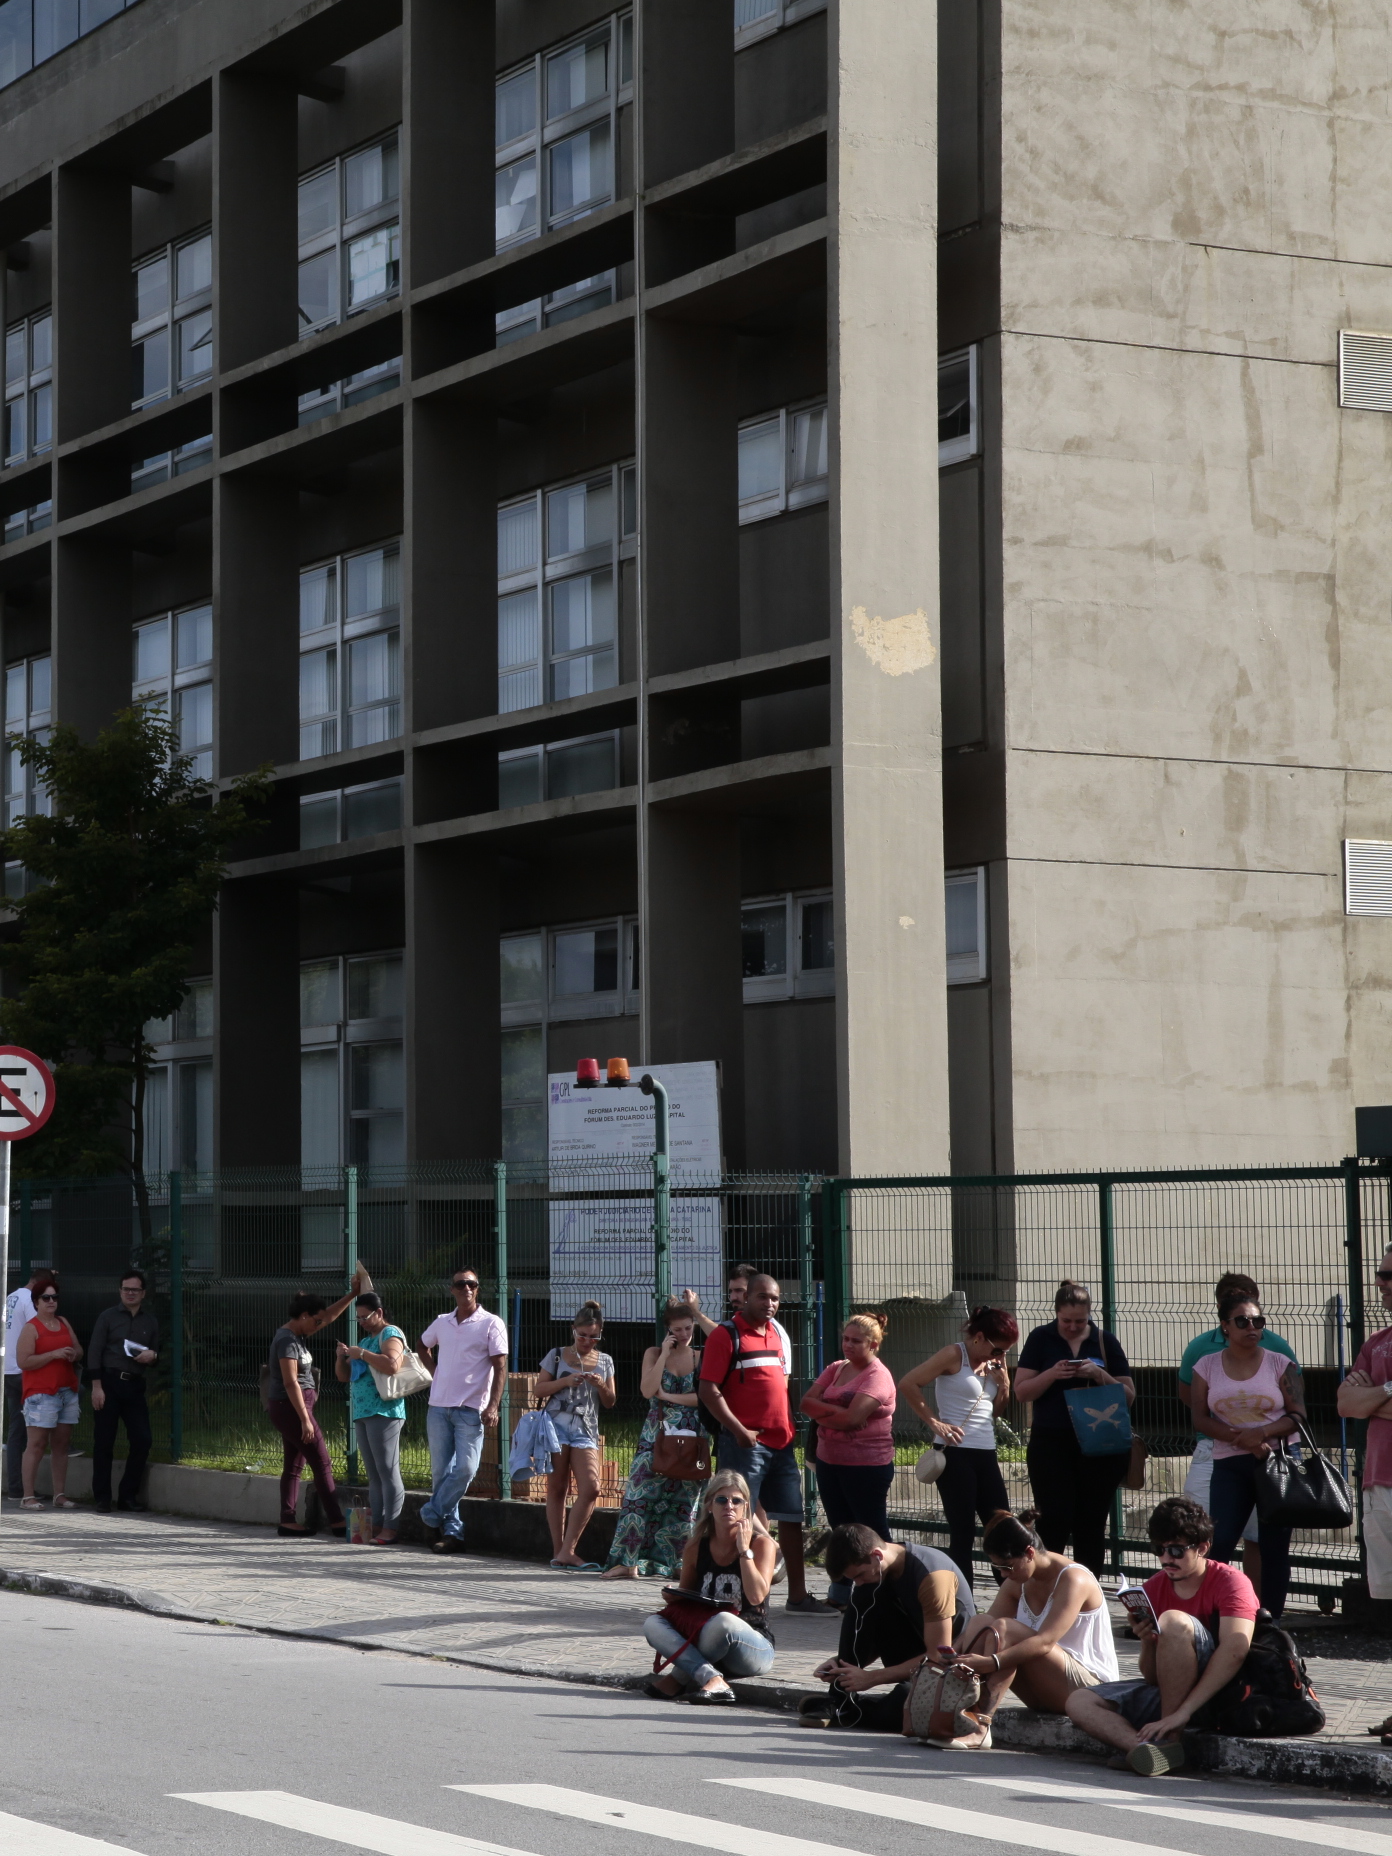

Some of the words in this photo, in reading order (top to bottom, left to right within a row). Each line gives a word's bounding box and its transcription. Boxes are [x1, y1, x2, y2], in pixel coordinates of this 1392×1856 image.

[587, 1107, 613, 1115] REFORMA
[613, 1105, 638, 1113] PARCIAL
[616, 1113, 645, 1121] EDUARDO
[677, 1205, 712, 1213] CATARINA
